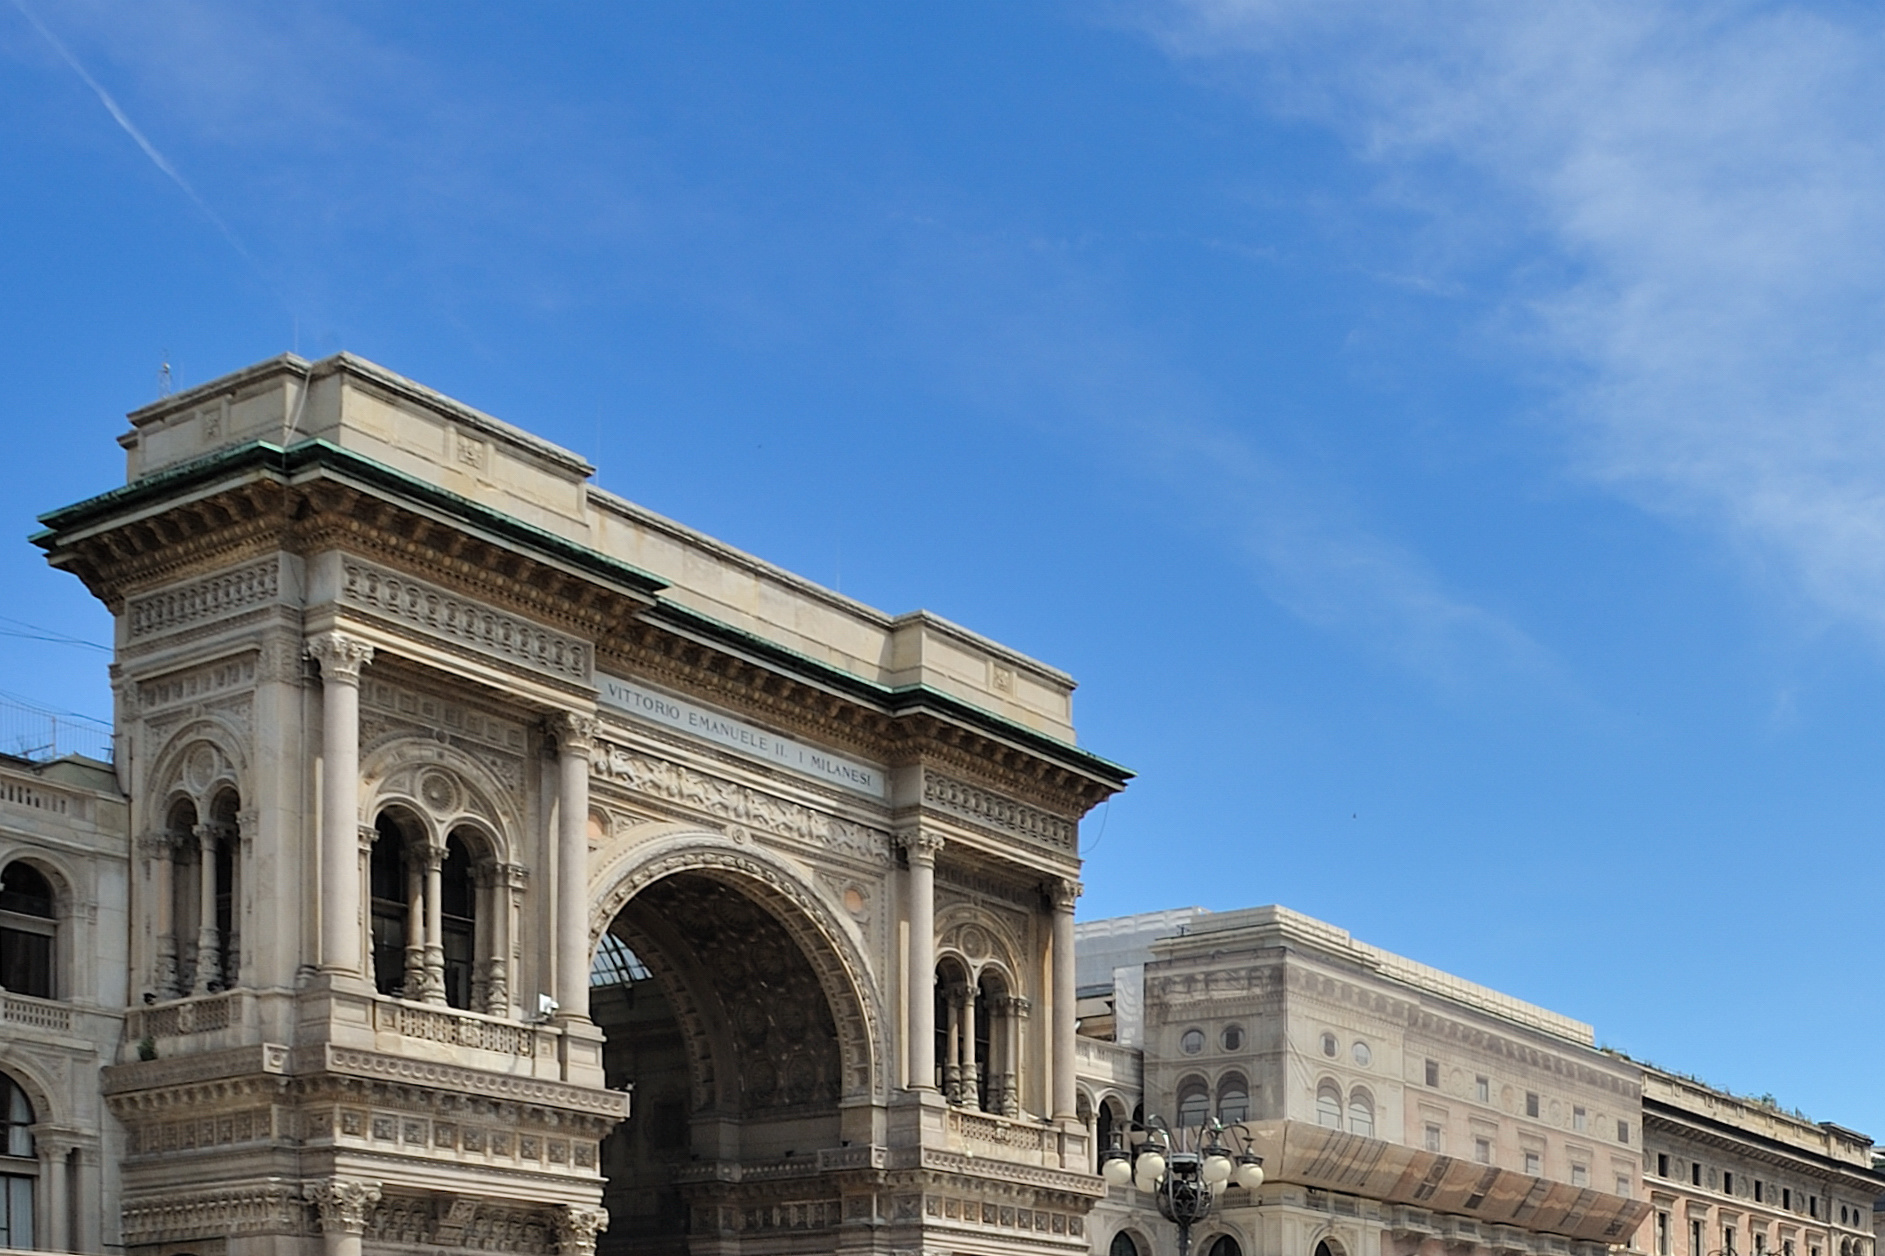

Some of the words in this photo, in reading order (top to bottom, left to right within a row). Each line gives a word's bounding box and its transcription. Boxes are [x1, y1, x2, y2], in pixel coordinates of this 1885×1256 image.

[608, 683, 680, 720] VITTORIO
[688, 712, 768, 751] EMANUELE
[775, 742, 788, 758] II.
[810, 755, 871, 786] MILANESI
